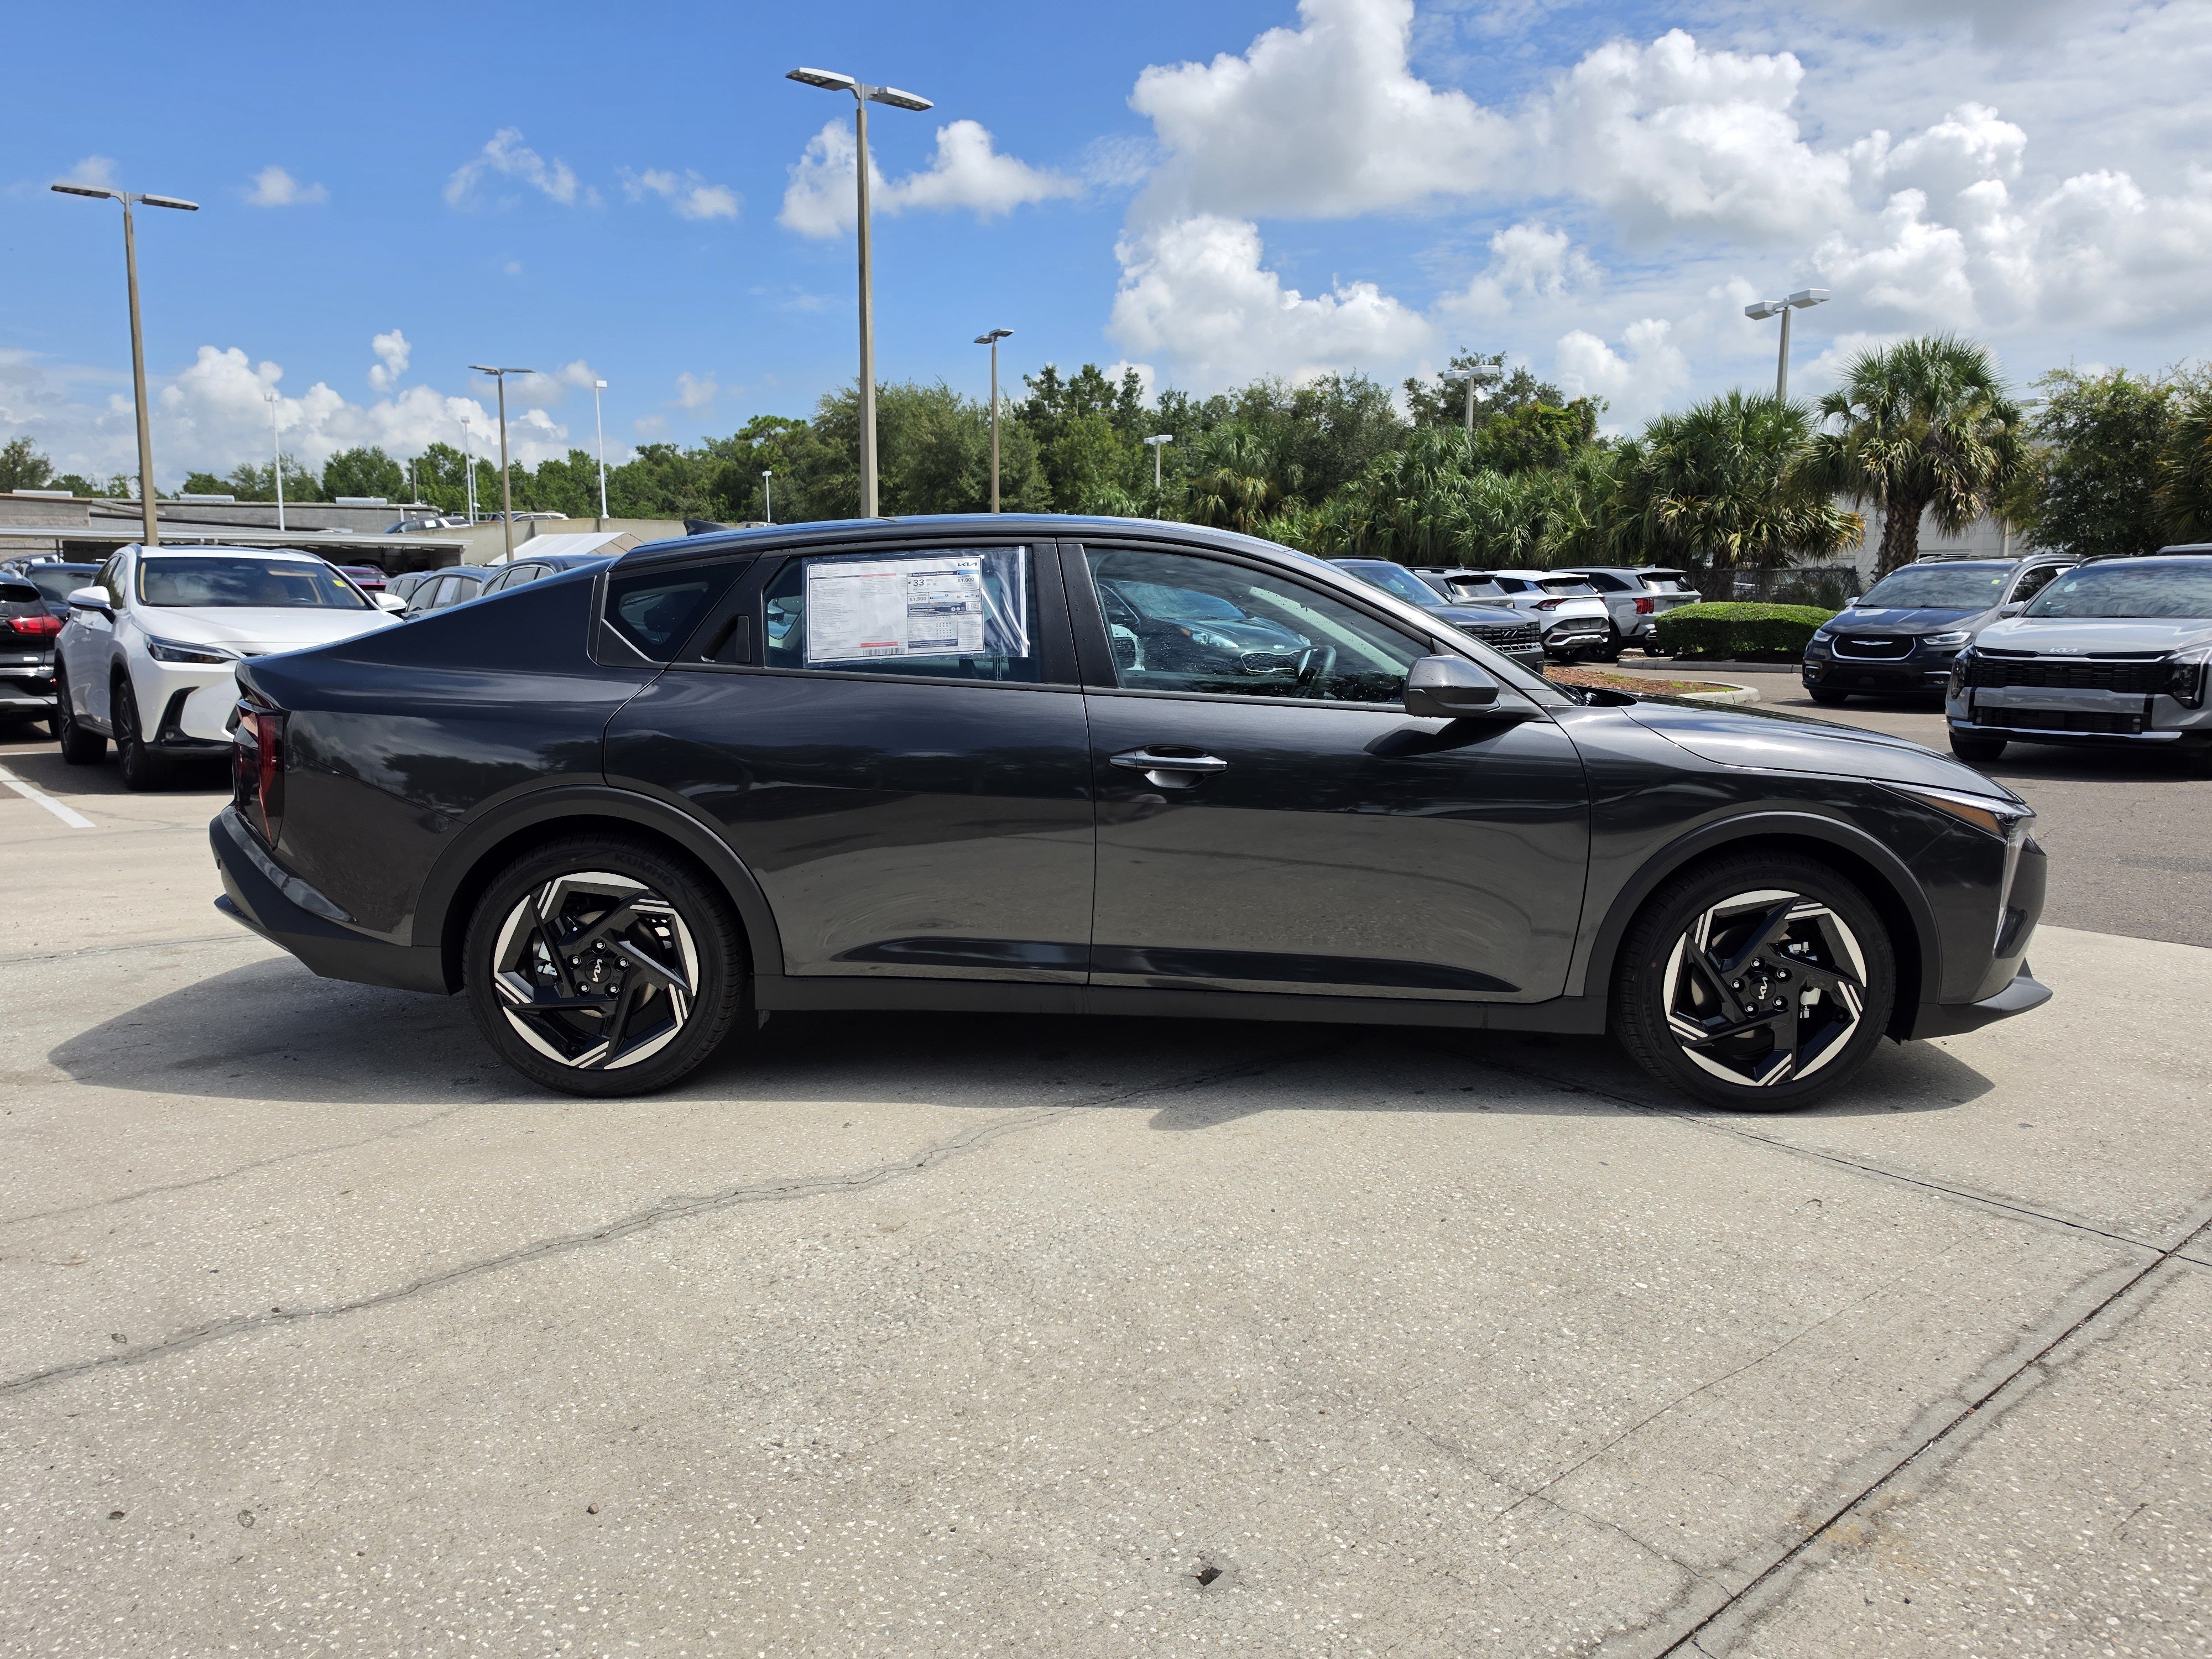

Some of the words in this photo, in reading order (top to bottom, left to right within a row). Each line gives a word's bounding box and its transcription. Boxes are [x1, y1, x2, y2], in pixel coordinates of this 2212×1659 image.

[614, 852, 675, 886] KUMHO
[592, 958, 603, 982] KIA
[1758, 977, 1768, 1000] KIA
[1643, 996, 1665, 1051] SOLUS
[526, 1061, 585, 1091] SOLUS
